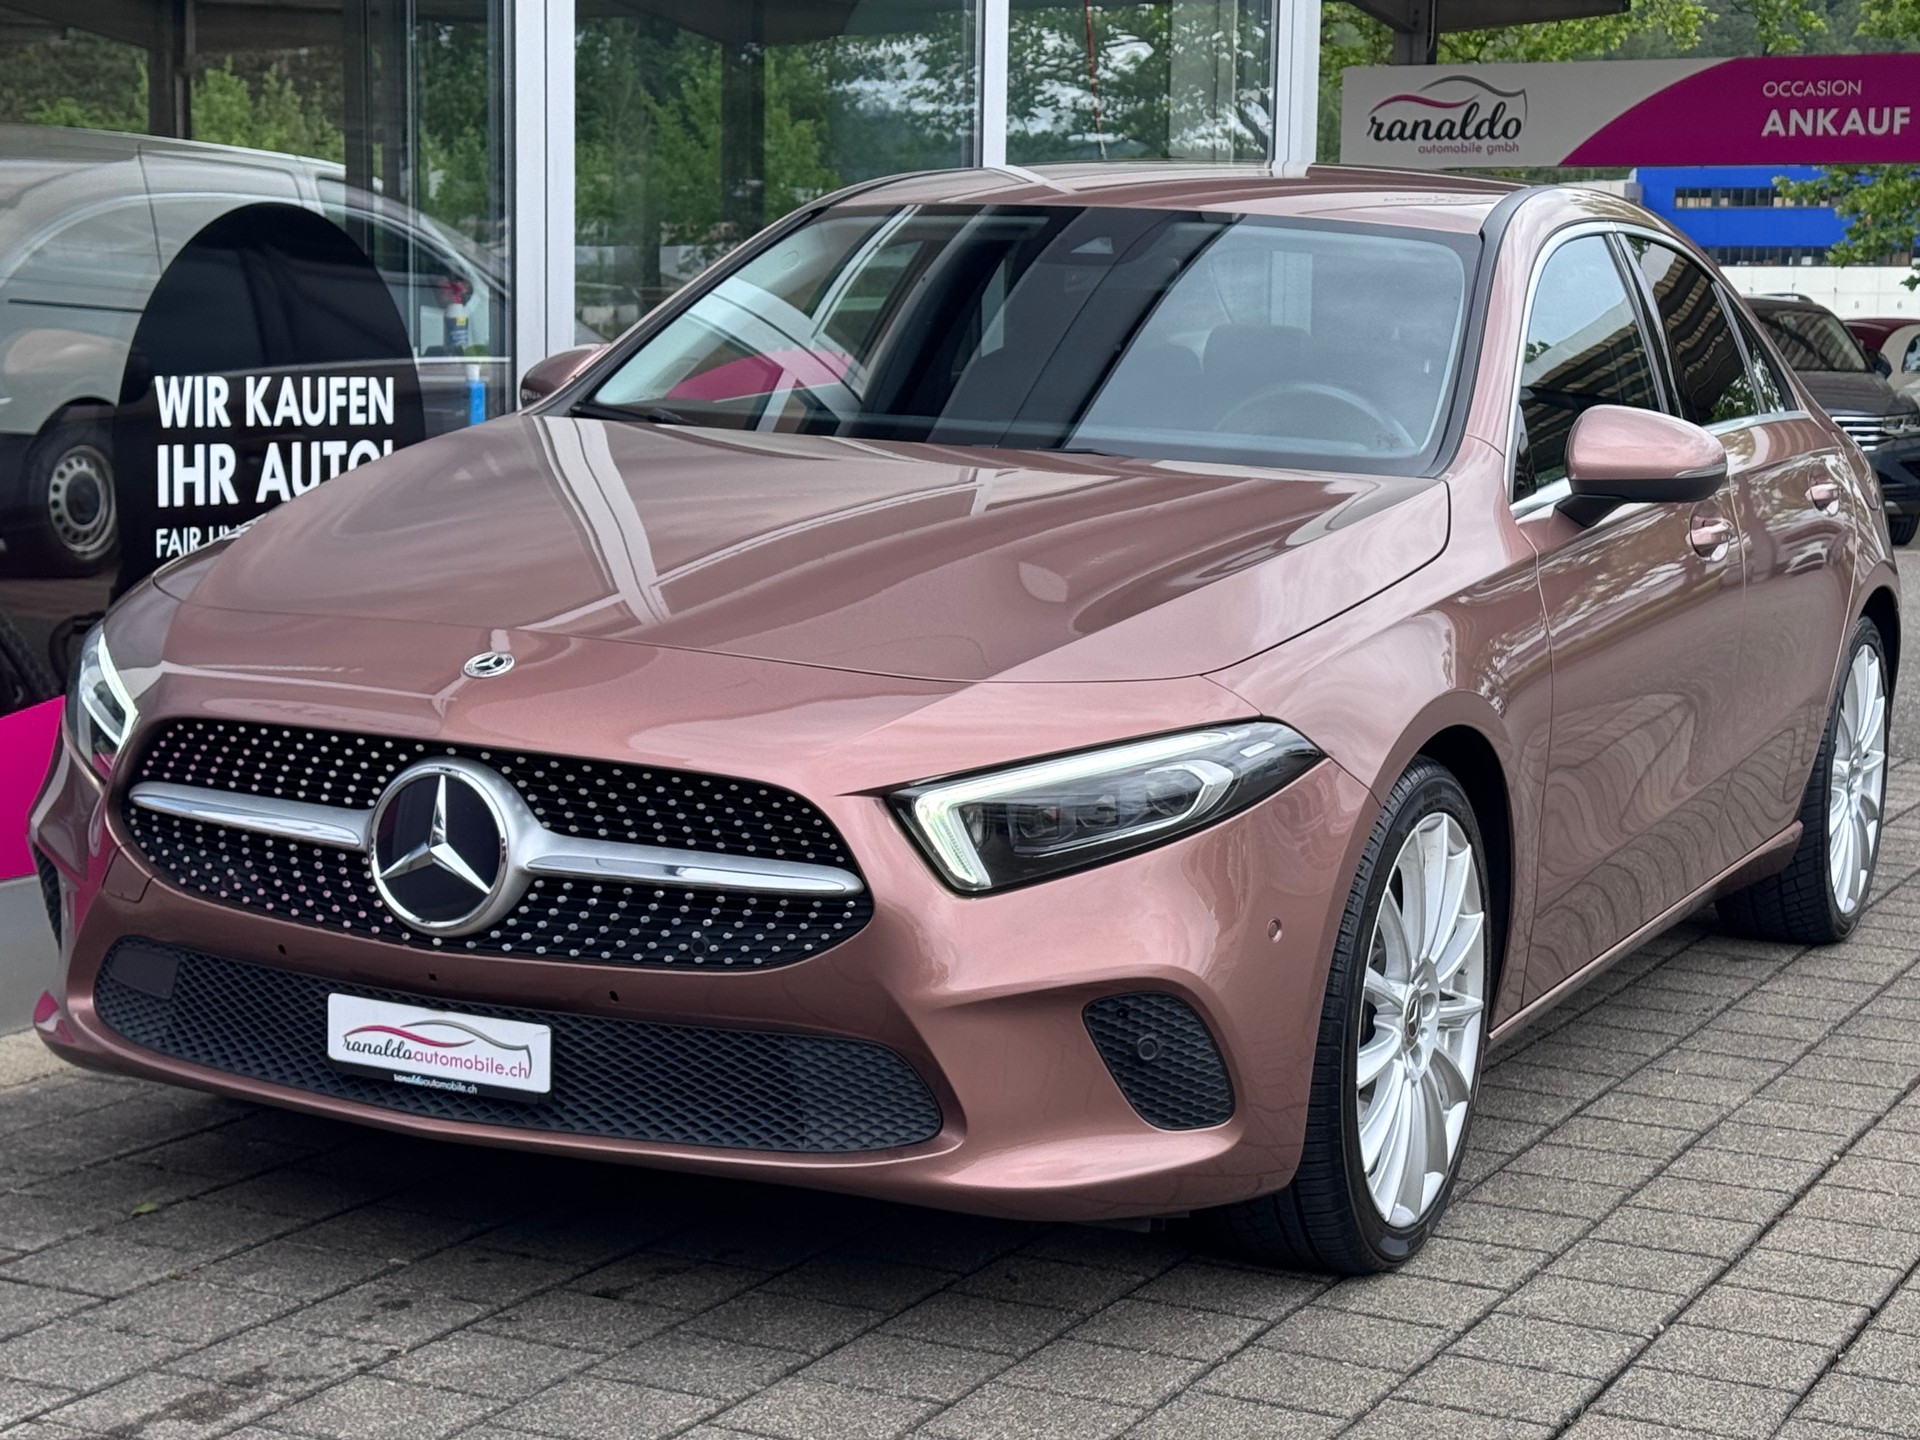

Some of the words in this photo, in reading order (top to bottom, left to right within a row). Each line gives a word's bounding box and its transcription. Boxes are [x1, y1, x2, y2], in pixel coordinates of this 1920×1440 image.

[1762, 80, 1862, 97] OCCASION
[1366, 101, 1522, 142] ranaldo
[1761, 106, 1911, 137] ANKAUF
[1418, 143, 1482, 155] automobile
[1486, 142, 1519, 156] gmbh
[154, 375, 232, 428] WIR
[245, 376, 395, 427] KAUFEN
[157, 443, 240, 508] IHR
[156, 526, 202, 558] FAIR
[342, 1036, 528, 1078] ranaldoautomobile.ch
